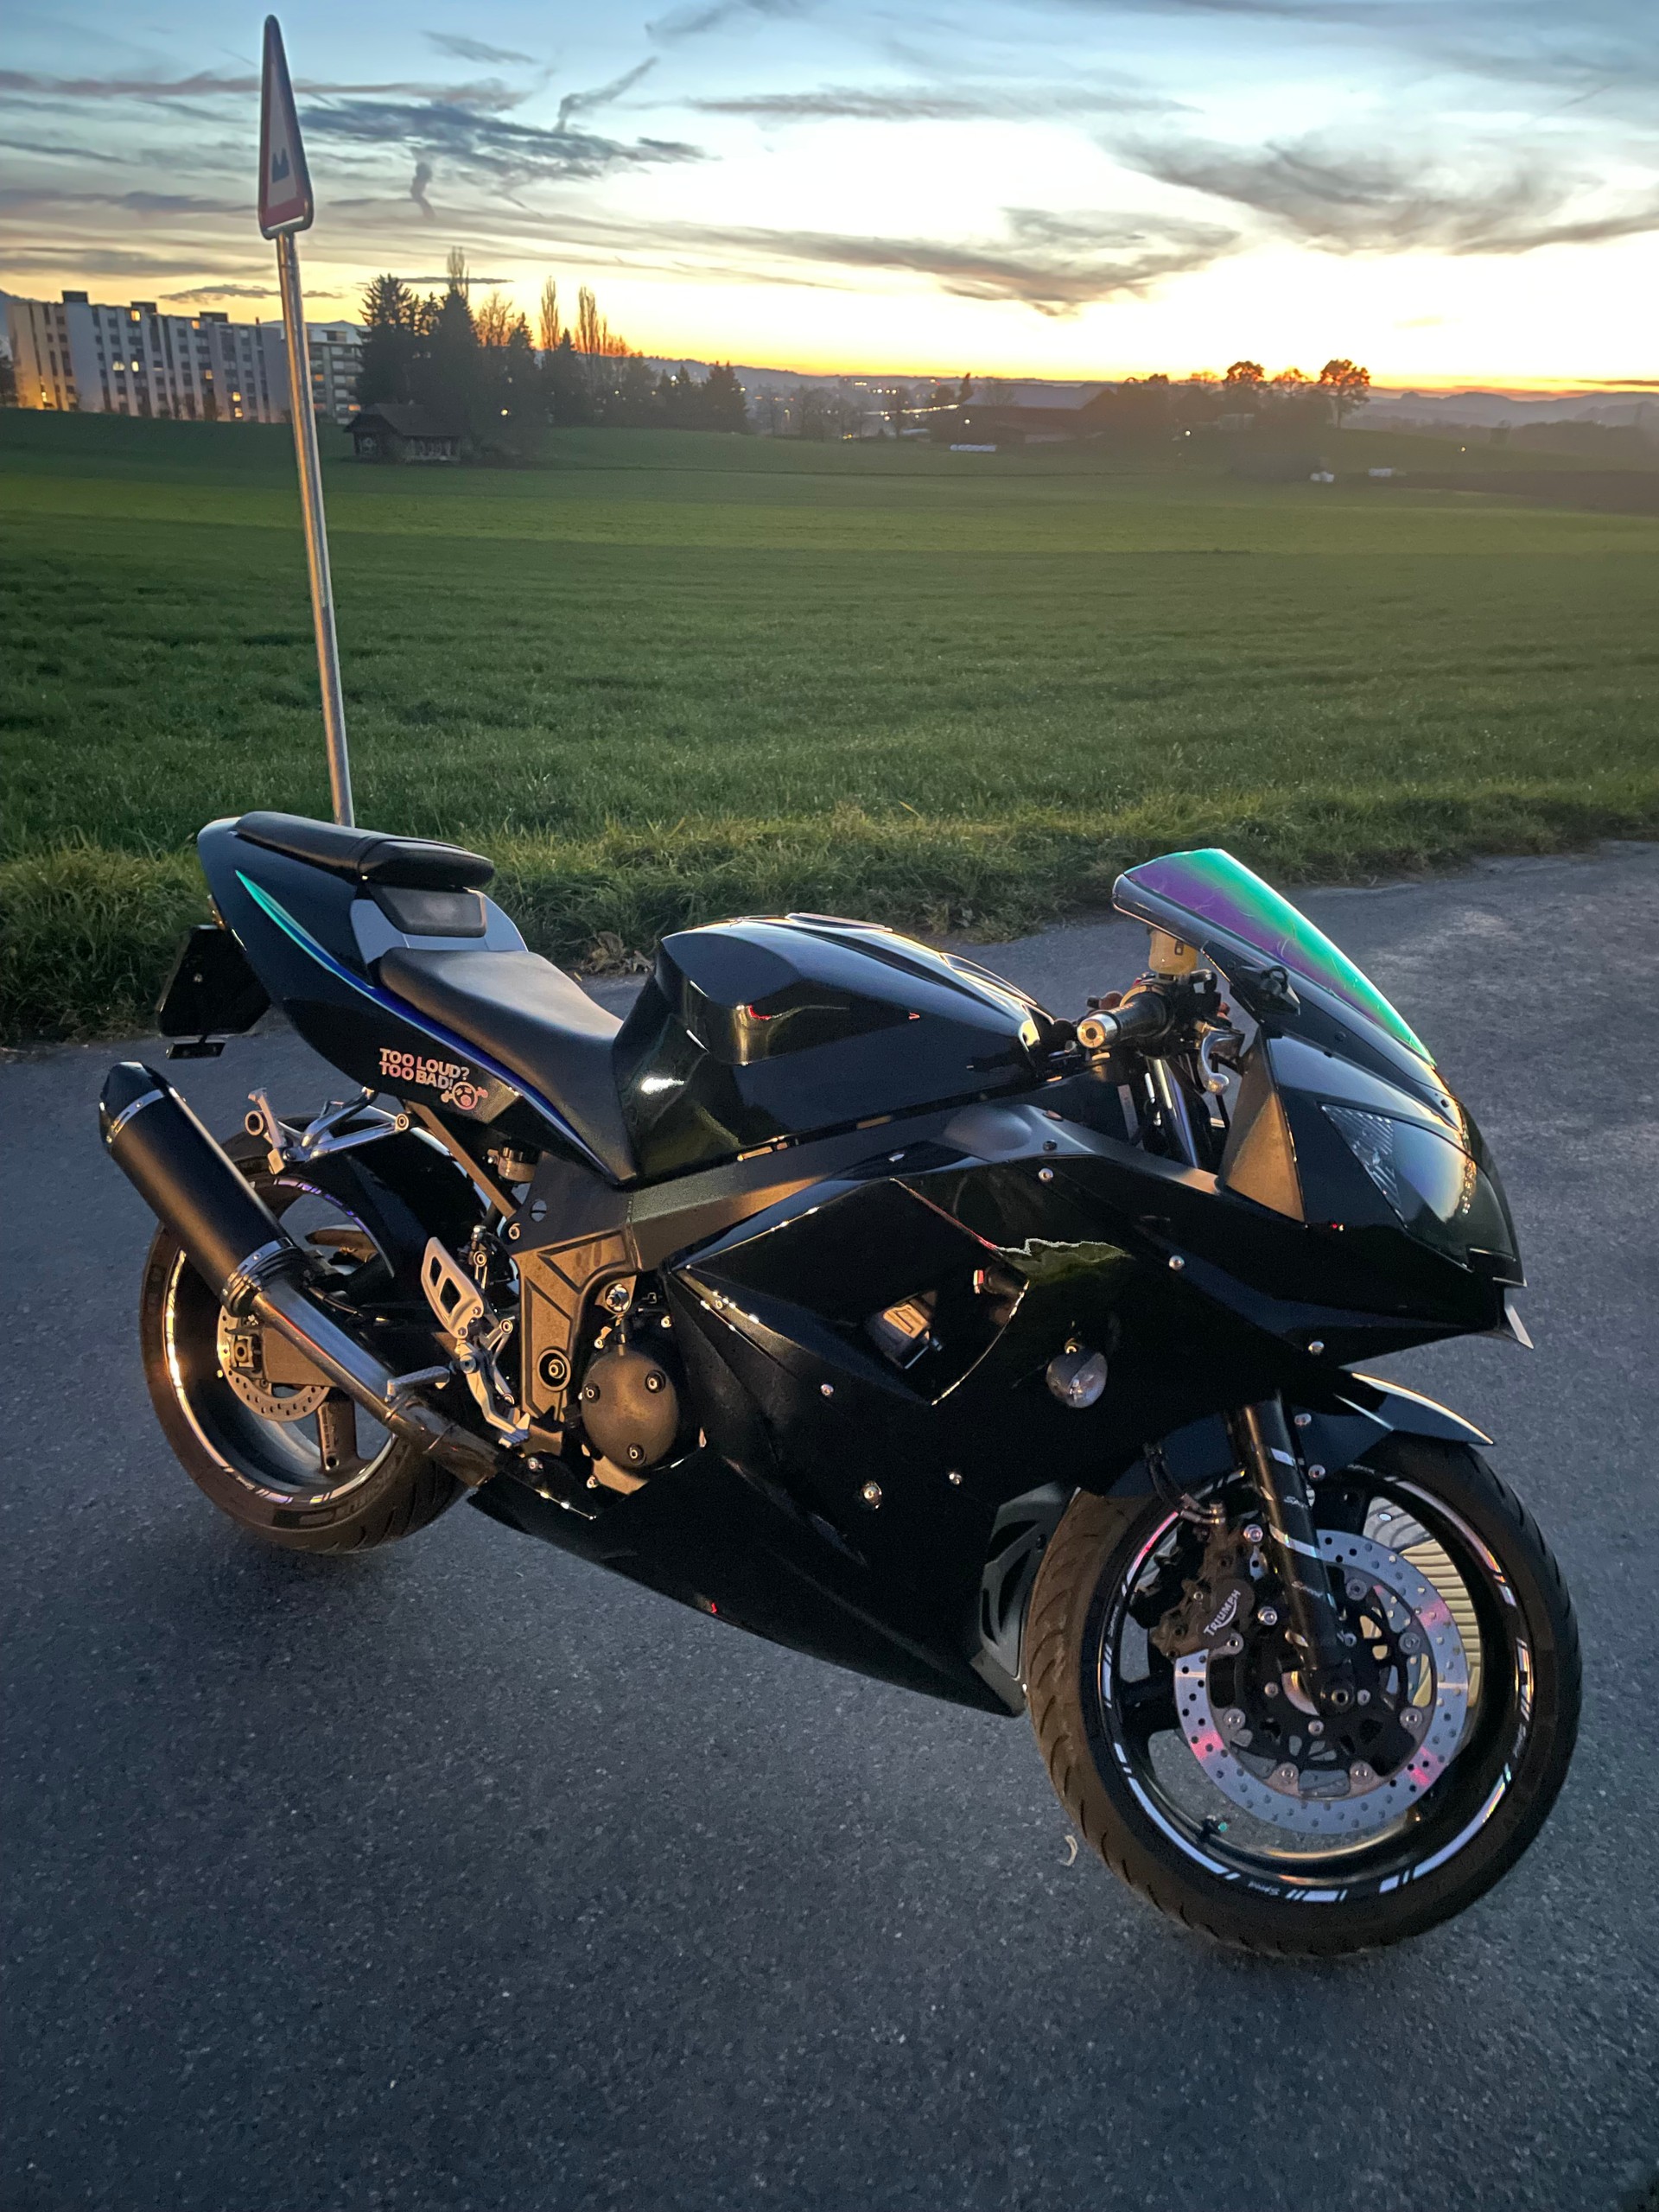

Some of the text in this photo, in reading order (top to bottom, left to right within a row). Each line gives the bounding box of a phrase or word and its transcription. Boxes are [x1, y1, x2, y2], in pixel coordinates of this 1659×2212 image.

[378, 1061, 454, 1090] TOO BAD!
[379, 1047, 470, 1080] TOO LOUD?
[1203, 1589, 1242, 1637] TRIUMPH
